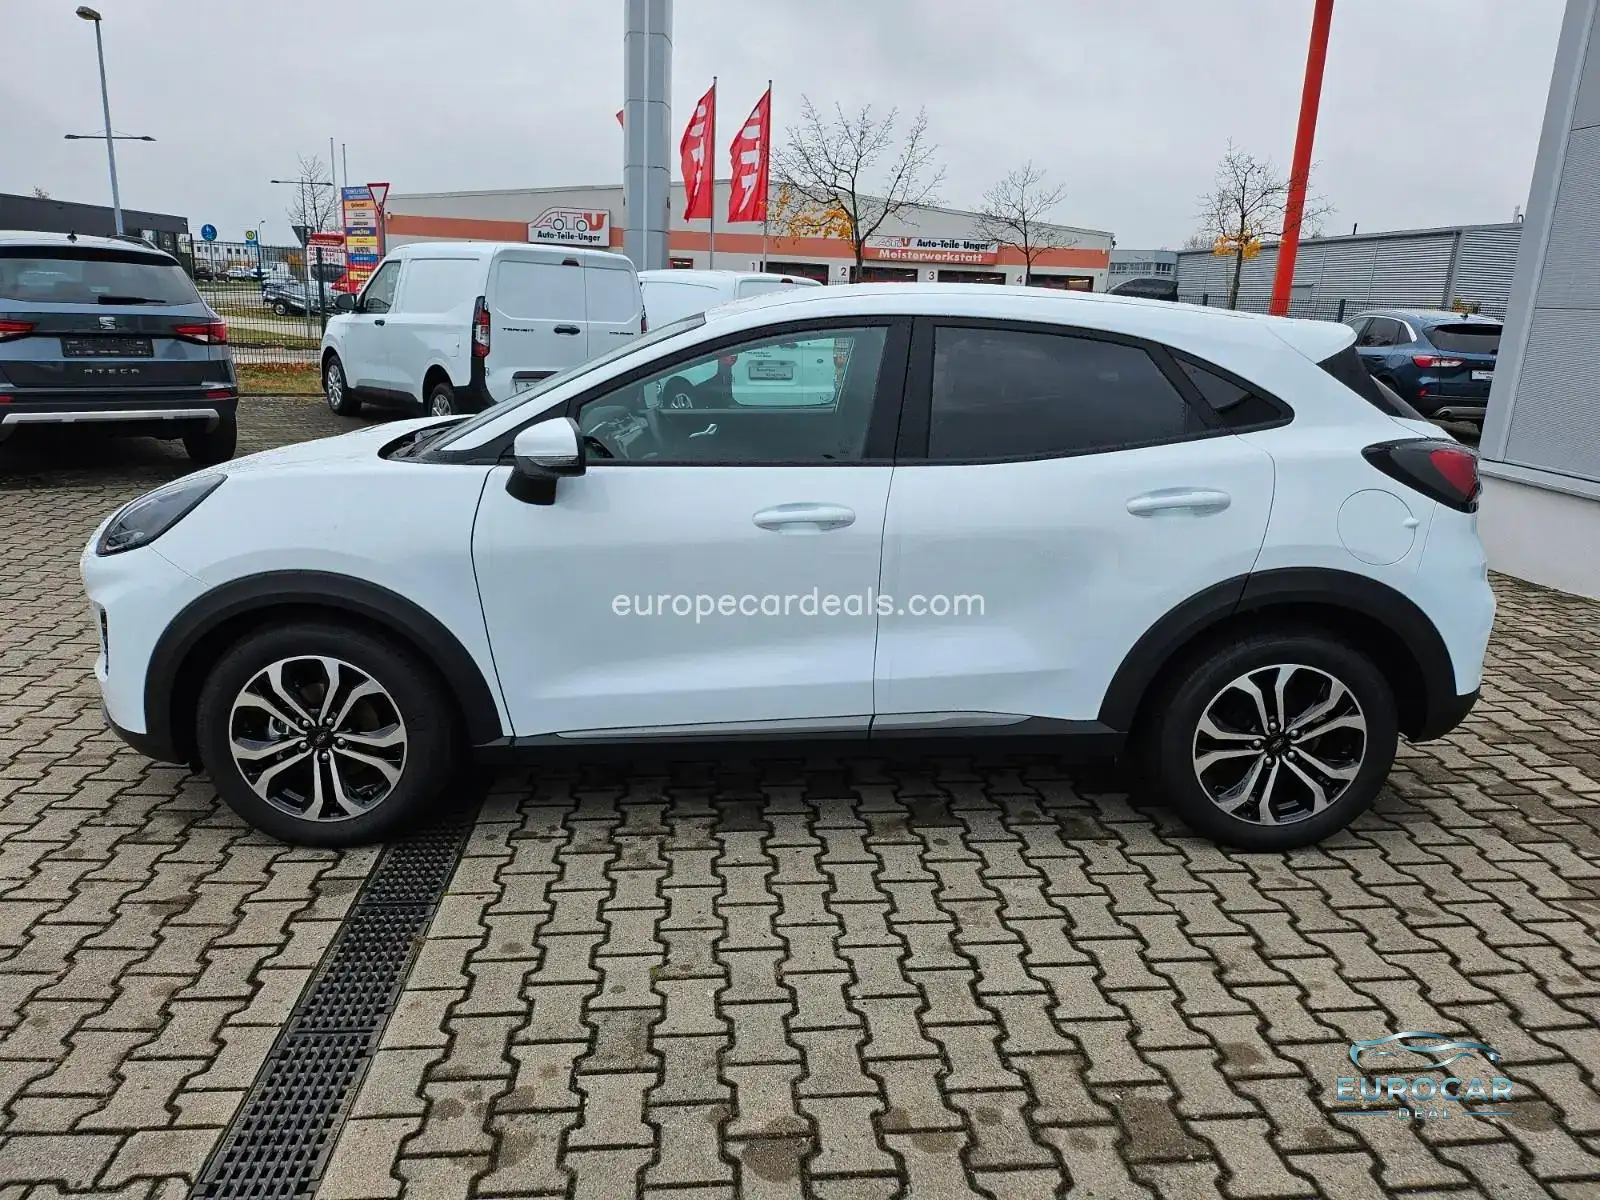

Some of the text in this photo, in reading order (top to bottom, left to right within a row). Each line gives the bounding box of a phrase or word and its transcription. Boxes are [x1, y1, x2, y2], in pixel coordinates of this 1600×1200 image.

[537, 230, 600, 242] Auto-Teile-Unger
[879, 249, 982, 262] Meisterwerkstatt
[751, 262, 755, 272] 1
[840, 267, 847, 276] 2
[928, 271, 935, 280] 3
[1016, 275, 1022, 284] 4
